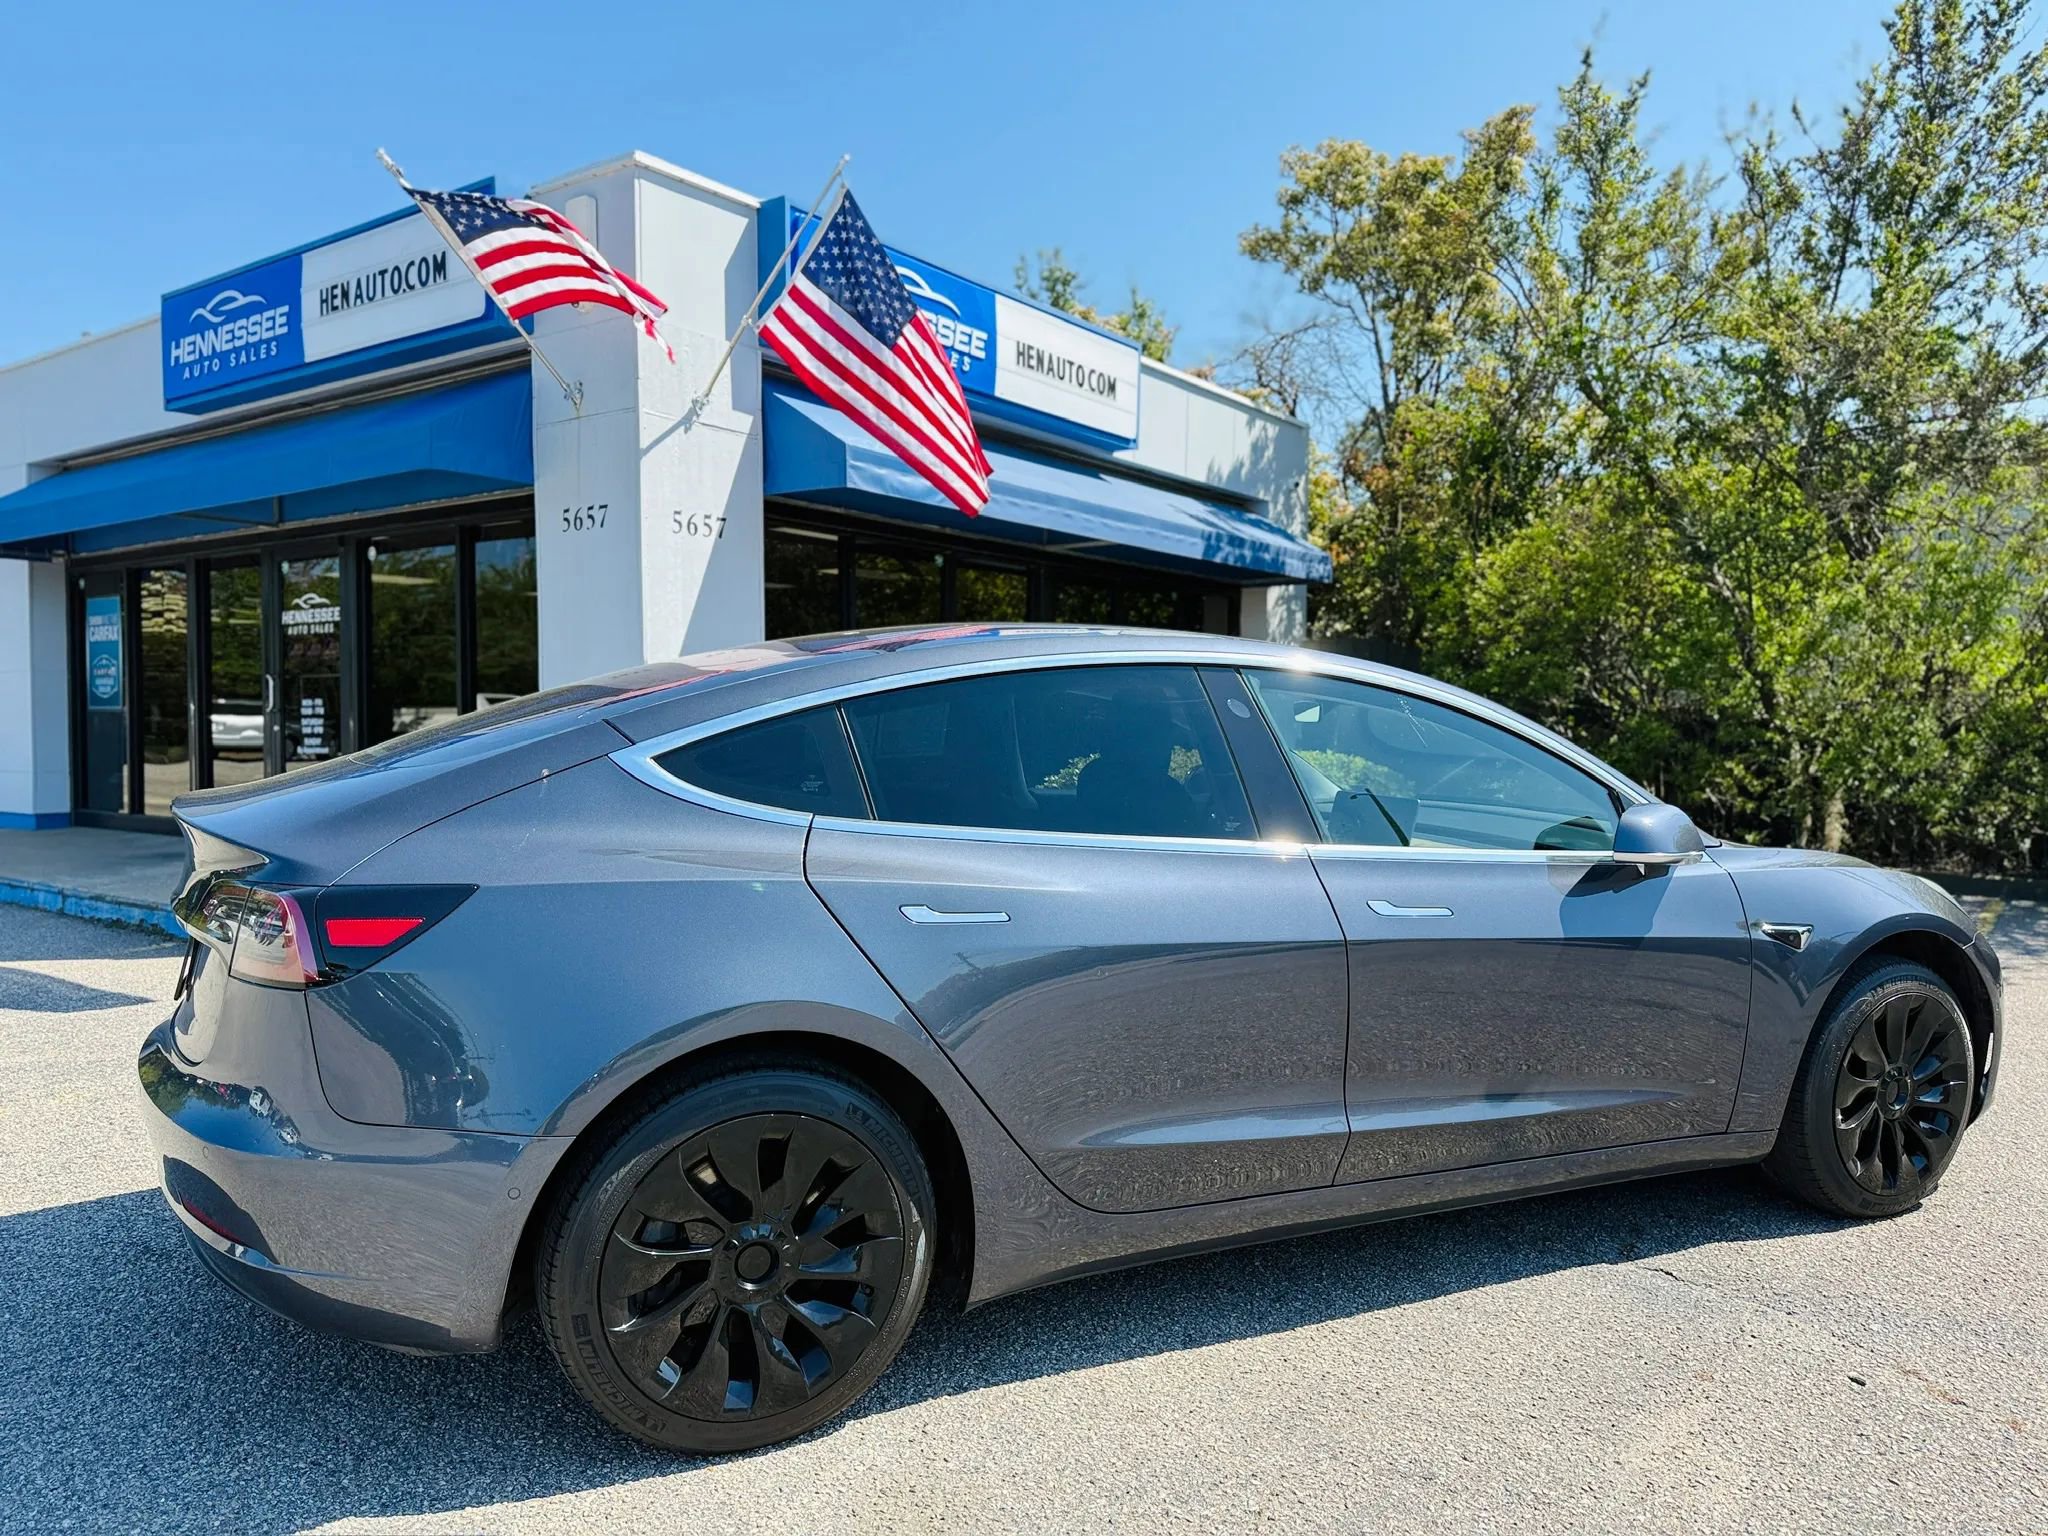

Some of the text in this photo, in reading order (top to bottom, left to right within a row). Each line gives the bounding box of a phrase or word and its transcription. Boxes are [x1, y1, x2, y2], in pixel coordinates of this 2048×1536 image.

[170, 305, 290, 367] HENNESSEE
[183, 341, 278, 380] AUTO SALES
[562, 504, 609, 532] 5657
[672, 510, 727, 539] 5657
[282, 607, 341, 625] HENNESSEE
